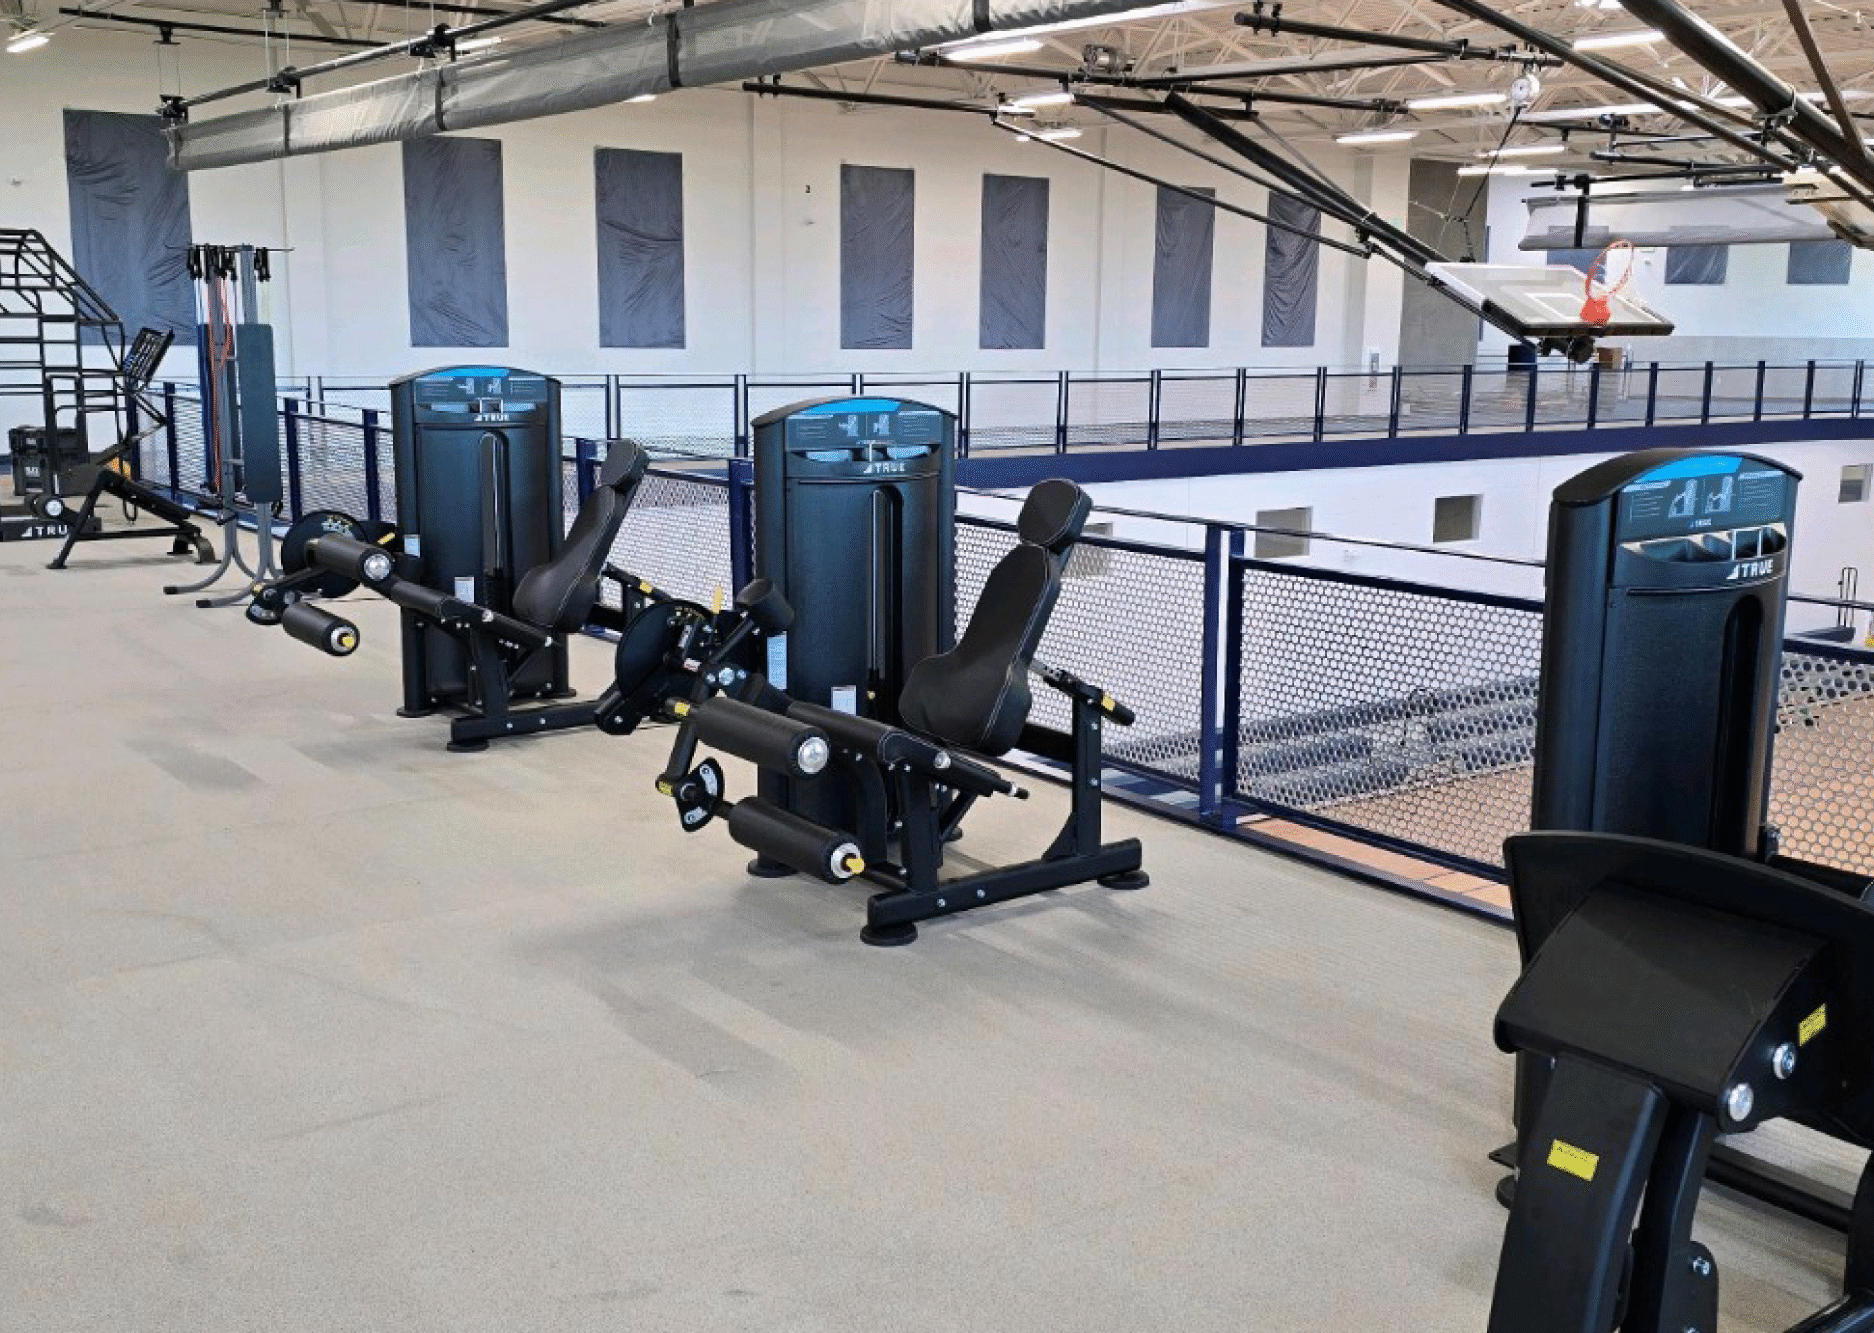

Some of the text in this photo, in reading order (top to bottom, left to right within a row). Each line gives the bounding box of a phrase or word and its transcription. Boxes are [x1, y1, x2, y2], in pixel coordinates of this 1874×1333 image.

[874, 462, 905, 474] TRUE
[35, 524, 70, 538] TRU
[1741, 559, 1774, 578] TRUE
